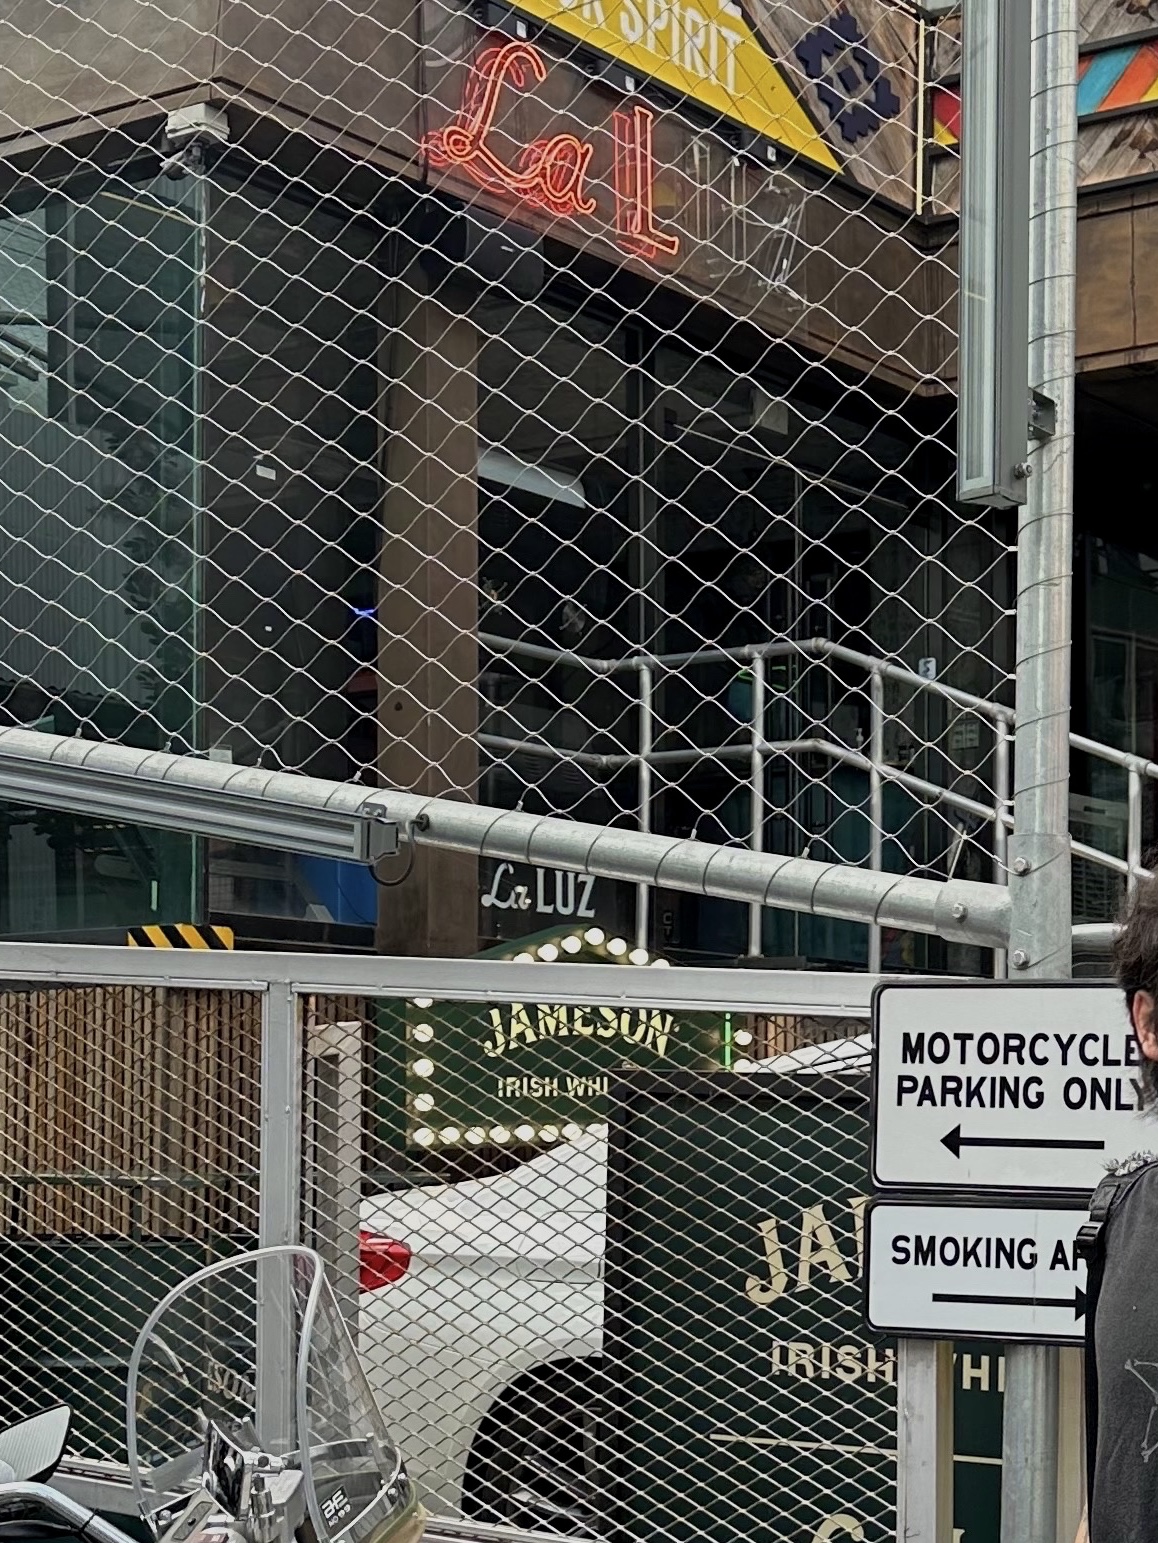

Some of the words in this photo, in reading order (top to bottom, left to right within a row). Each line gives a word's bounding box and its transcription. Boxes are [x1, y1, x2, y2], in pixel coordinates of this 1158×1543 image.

[619, 0, 746, 96] SPIRIT
[442, 40, 597, 215] La
[481, 863, 531, 909] La
[536, 867, 596, 918] LUZ
[484, 1002, 675, 1057] JAMESON
[901, 1031, 1143, 1067] MOTORCYCLE
[497, 1077, 558, 1098] IRISH
[896, 1074, 1045, 1109] PARKING
[1062, 1076, 1144, 1111] ONLY
[744, 1194, 867, 1304] JA
[891, 1234, 1038, 1270] SMOKING
[771, 1339, 897, 1384] IRISH
